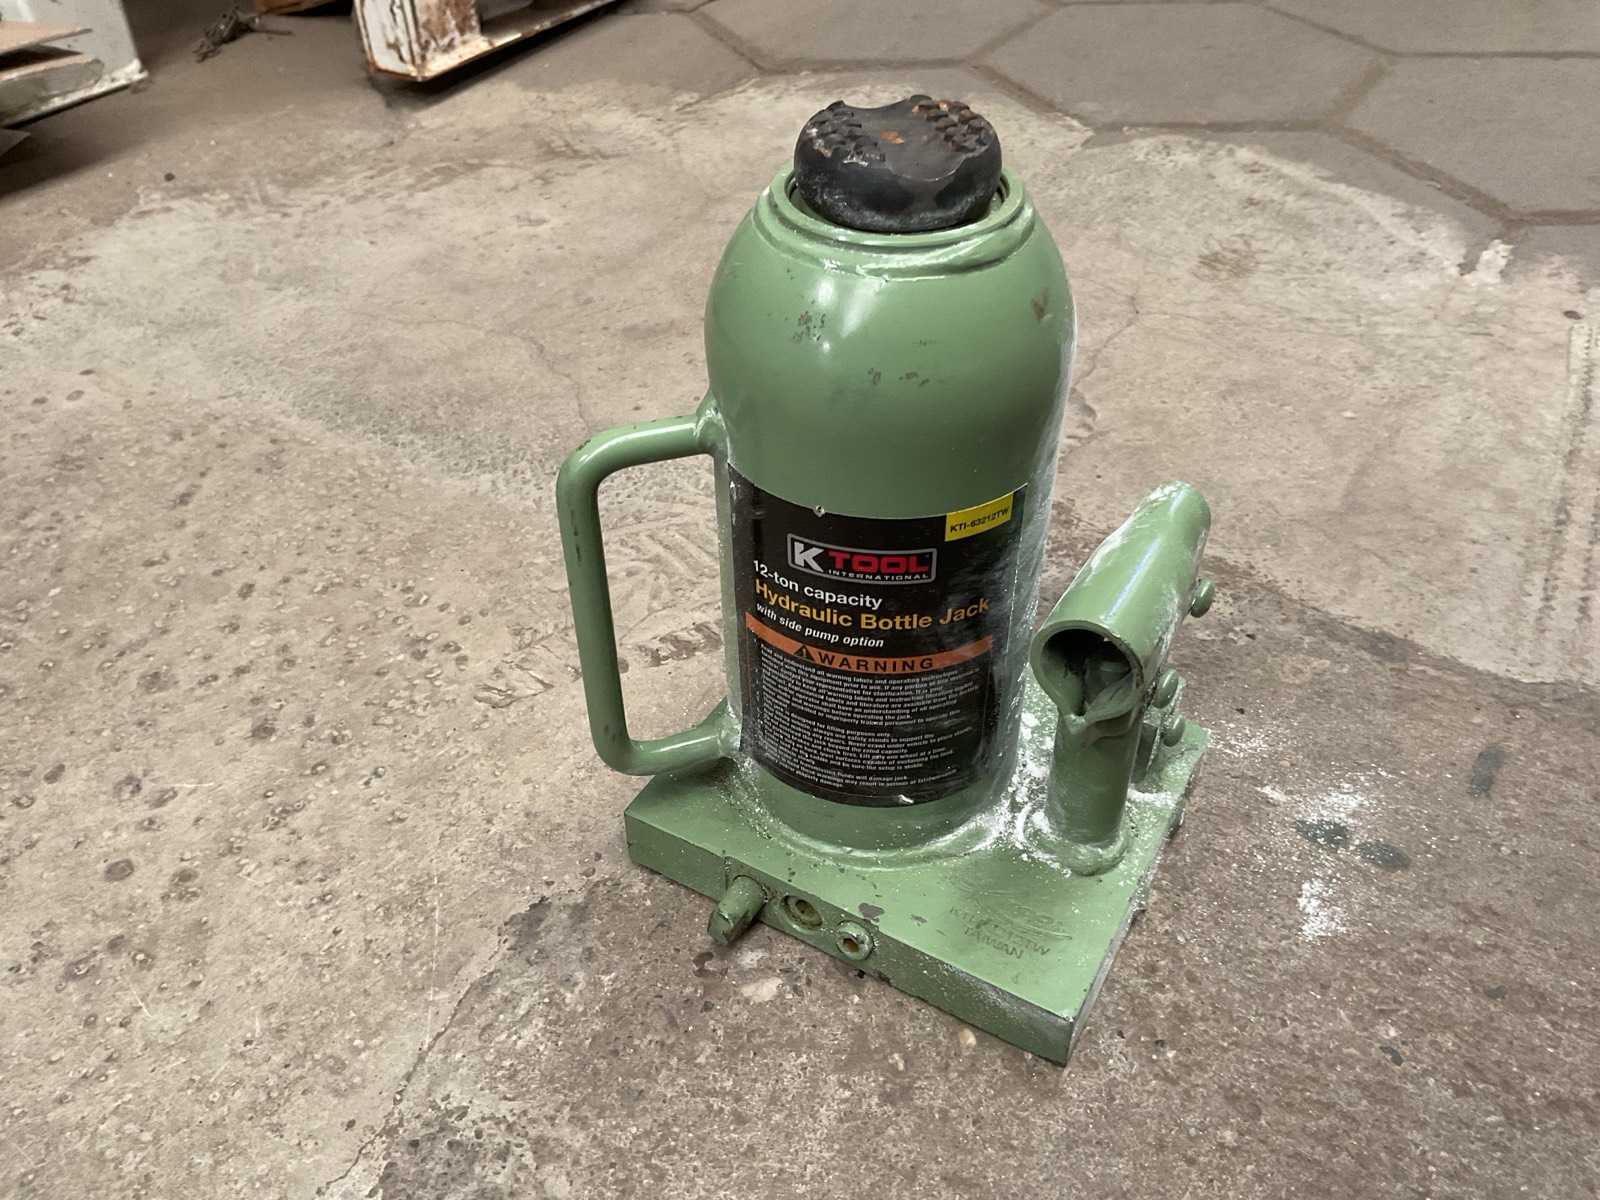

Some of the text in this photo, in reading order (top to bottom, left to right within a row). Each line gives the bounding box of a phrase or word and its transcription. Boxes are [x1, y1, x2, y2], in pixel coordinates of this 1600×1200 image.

[950, 508, 1009, 533] KTI-63212TW
[793, 541, 929, 574] K TOOL
[753, 560, 883, 611] 12-ton capacity
[828, 569, 929, 581] INTERNATIONAL
[755, 578, 990, 631] Hydraulic Bottle Jack
[756, 603, 885, 649] with side pump option
[818, 652, 934, 673] WARNING
